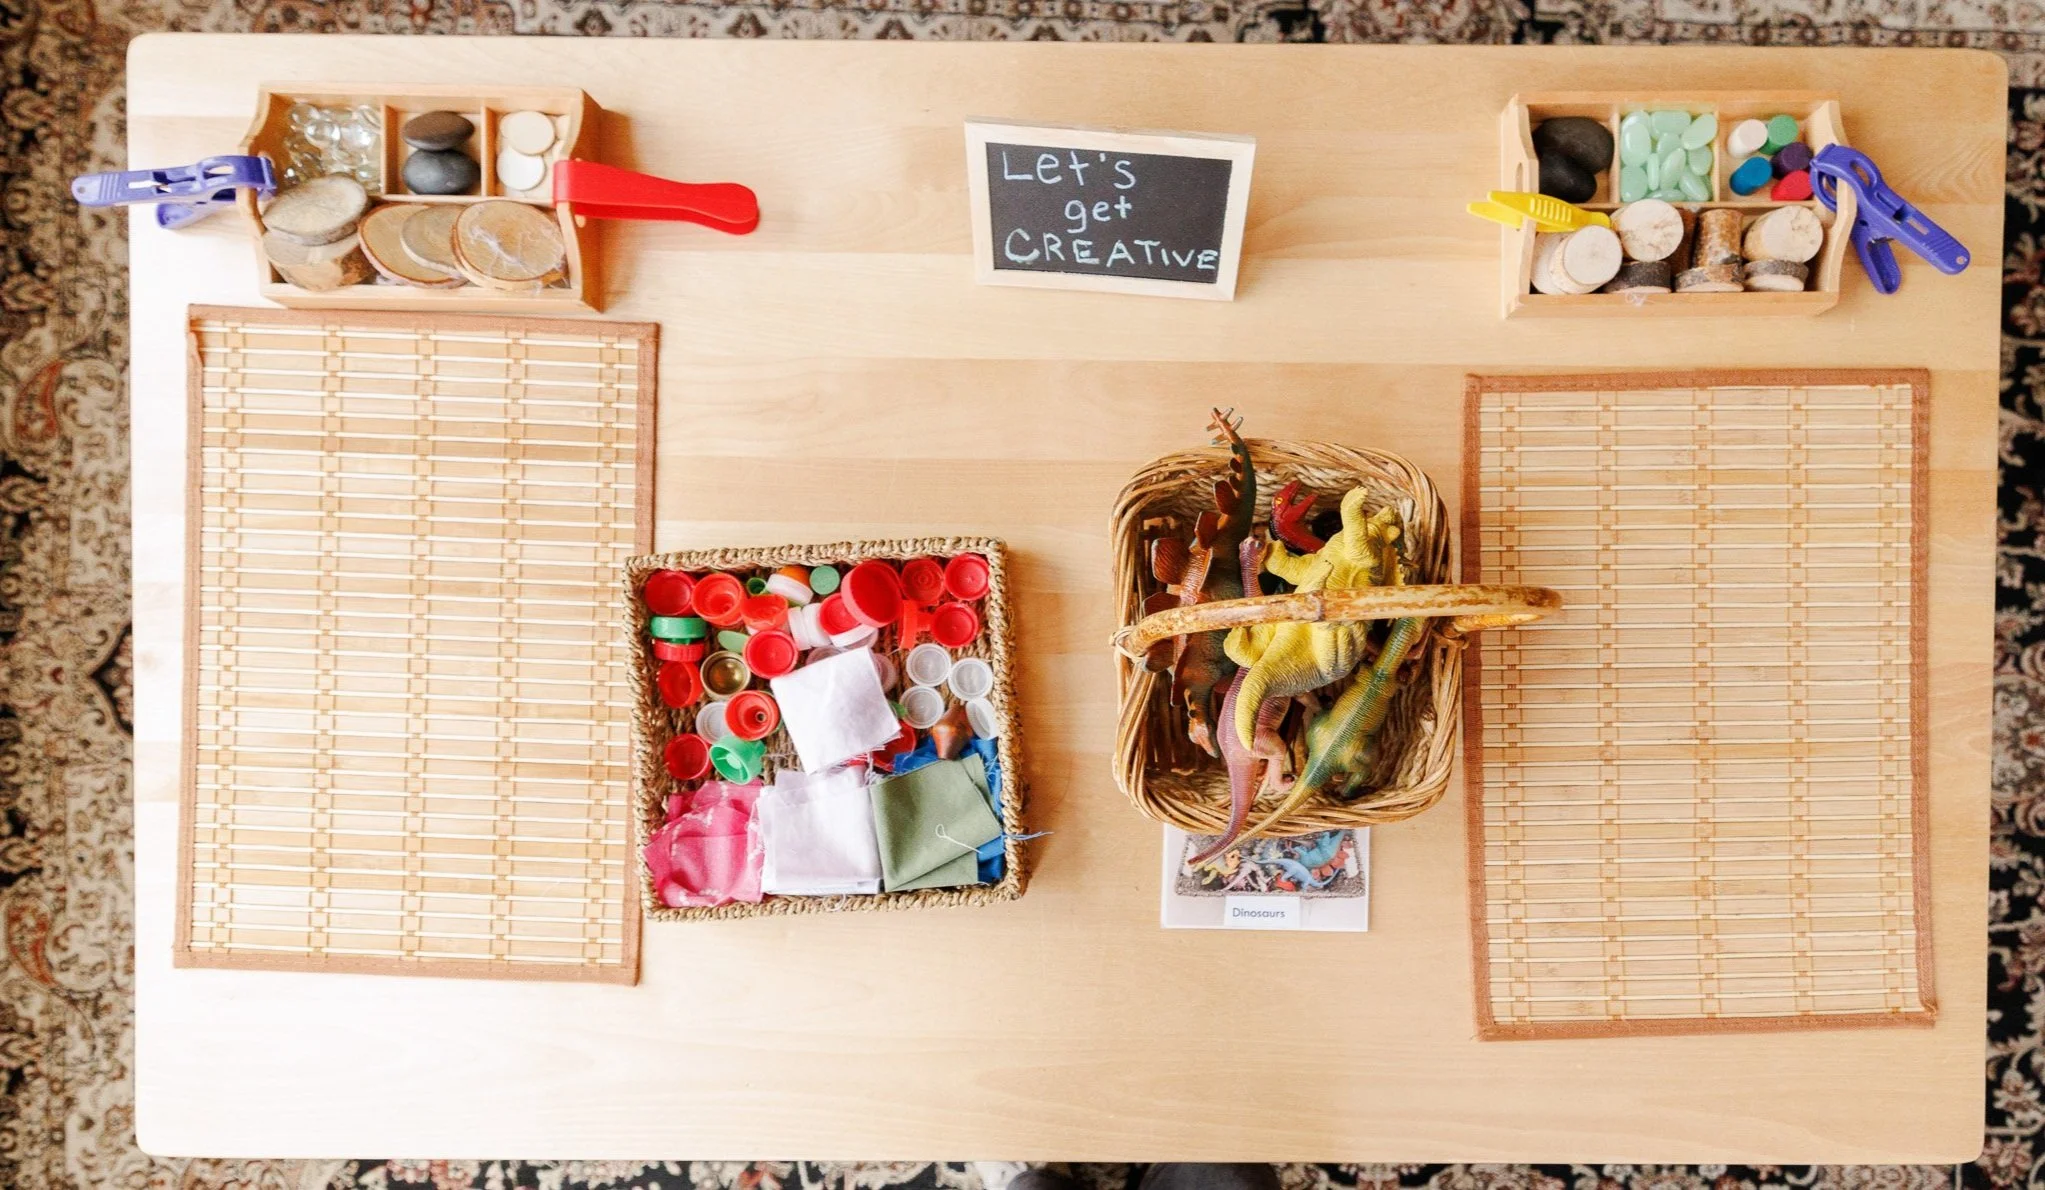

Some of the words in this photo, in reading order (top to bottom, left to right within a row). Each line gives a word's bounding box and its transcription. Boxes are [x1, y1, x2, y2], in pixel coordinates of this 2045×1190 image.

[1001, 150, 1137, 190] Let's
[1064, 195, 1133, 234] get
[1004, 228, 1220, 270] CREATIVE
[1232, 907, 1286, 918] Dinosaurs
